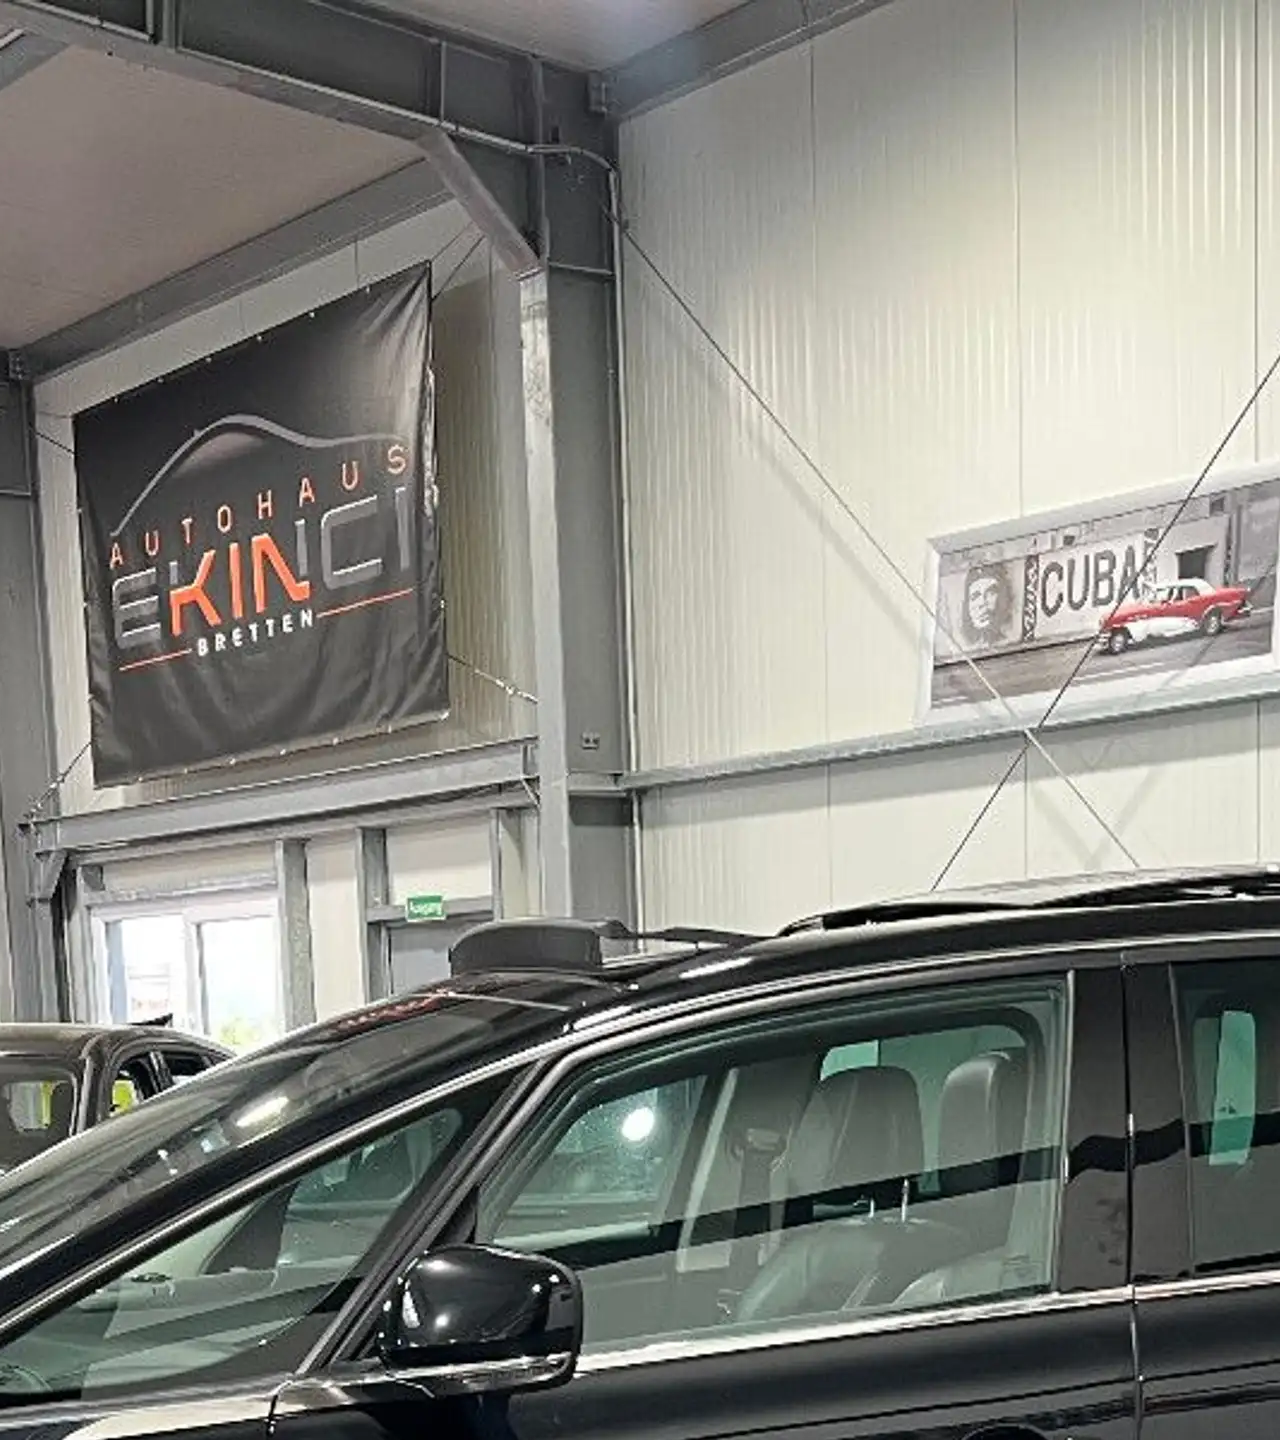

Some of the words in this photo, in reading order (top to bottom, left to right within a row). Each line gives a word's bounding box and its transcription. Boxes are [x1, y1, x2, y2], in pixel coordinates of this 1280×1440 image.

[109, 445, 408, 567] AUTOHAUS
[111, 486, 410, 649] EKINCI
[1040, 544, 1143, 619] CUBA
[197, 609, 315, 657] BRETTEN
